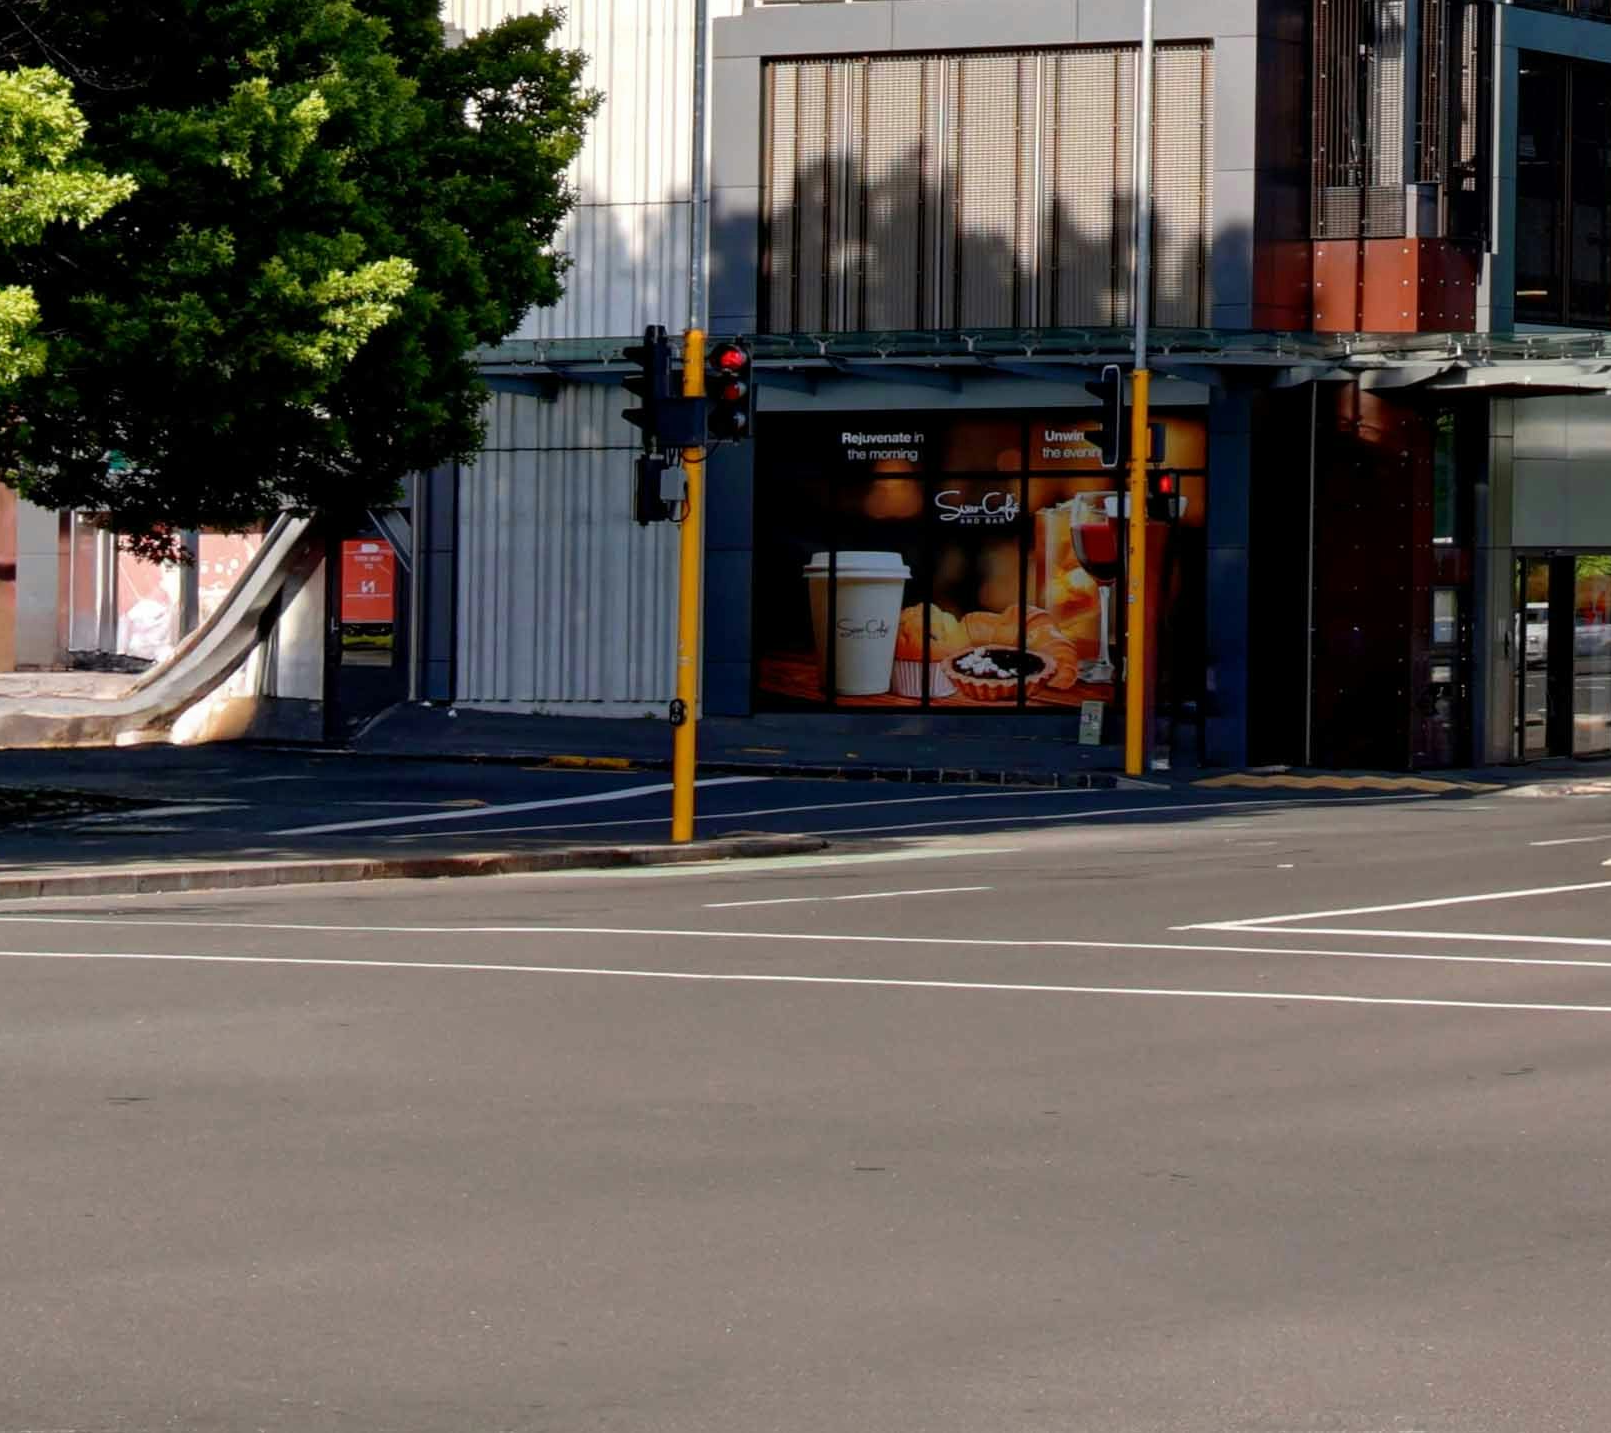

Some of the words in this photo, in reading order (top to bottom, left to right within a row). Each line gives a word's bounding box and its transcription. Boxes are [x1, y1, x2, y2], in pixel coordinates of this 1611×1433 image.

[841, 431, 912, 446] Rejuvenate
[914, 431, 924, 444] in
[1044, 430, 1086, 442] Unwin
[847, 448, 867, 460] the
[869, 447, 918, 462] morning
[1043, 447, 1061, 459] the
[1063, 447, 1103, 459] evenin
